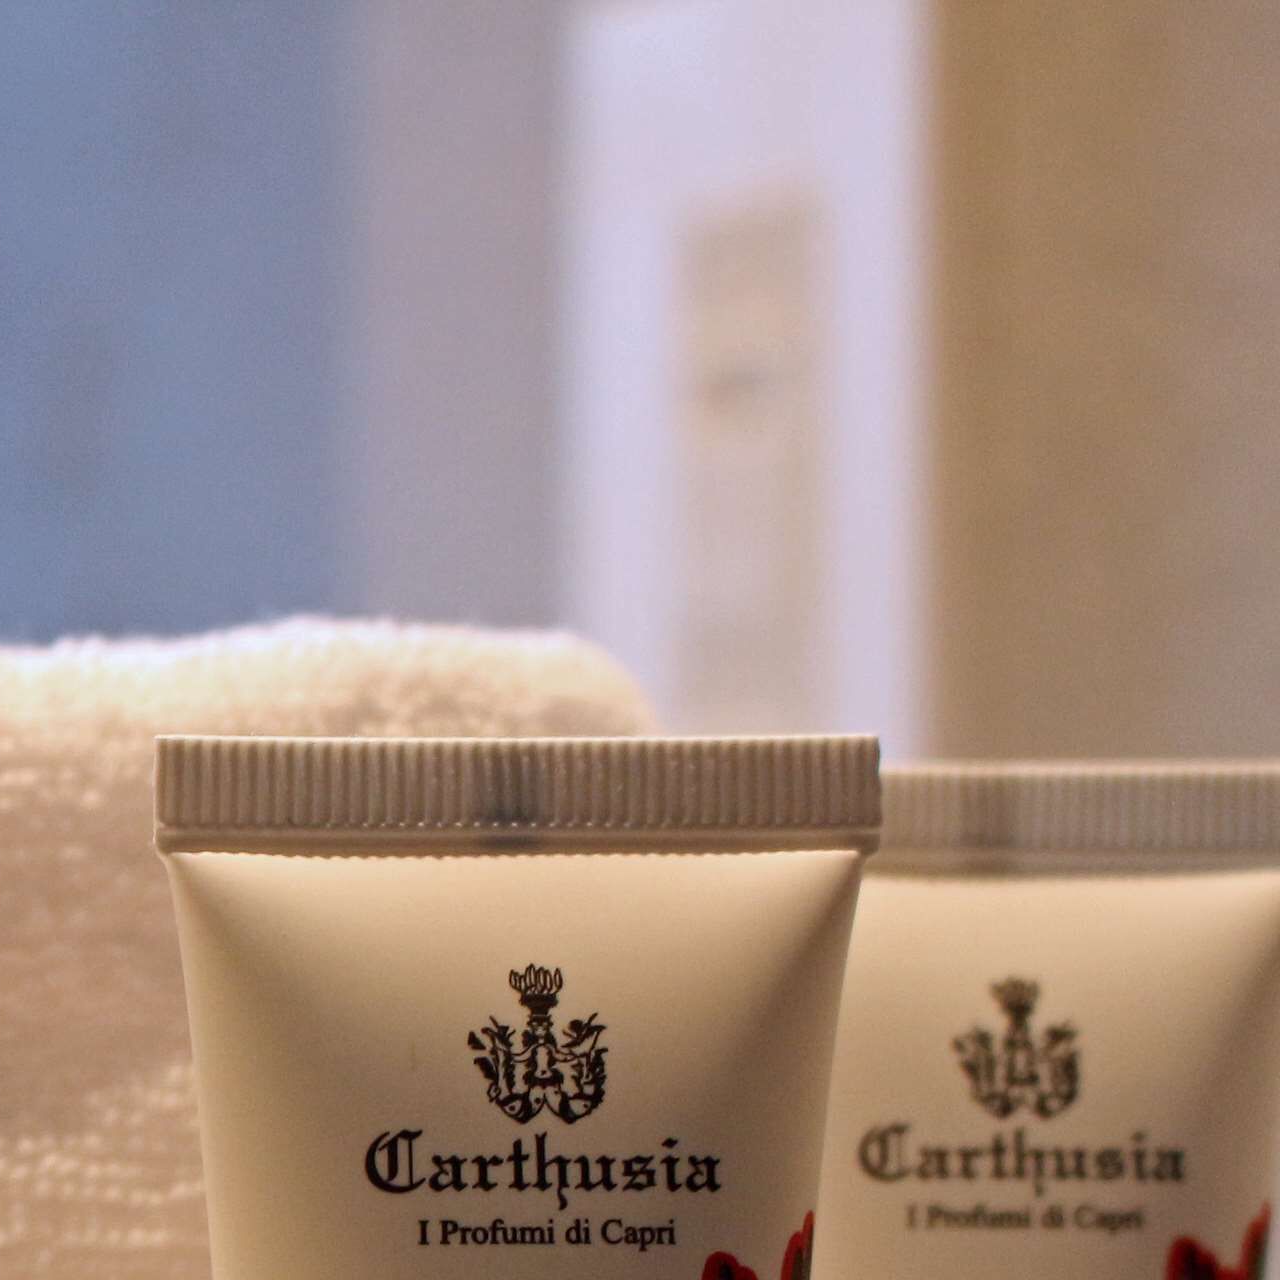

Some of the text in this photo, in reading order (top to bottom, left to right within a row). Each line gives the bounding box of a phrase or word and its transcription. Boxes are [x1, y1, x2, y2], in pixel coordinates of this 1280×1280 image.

[364, 1128, 722, 1210] Carthusia
[858, 1122, 1188, 1196] Carthusia
[418, 1218, 677, 1252] I Profumi di Capri
